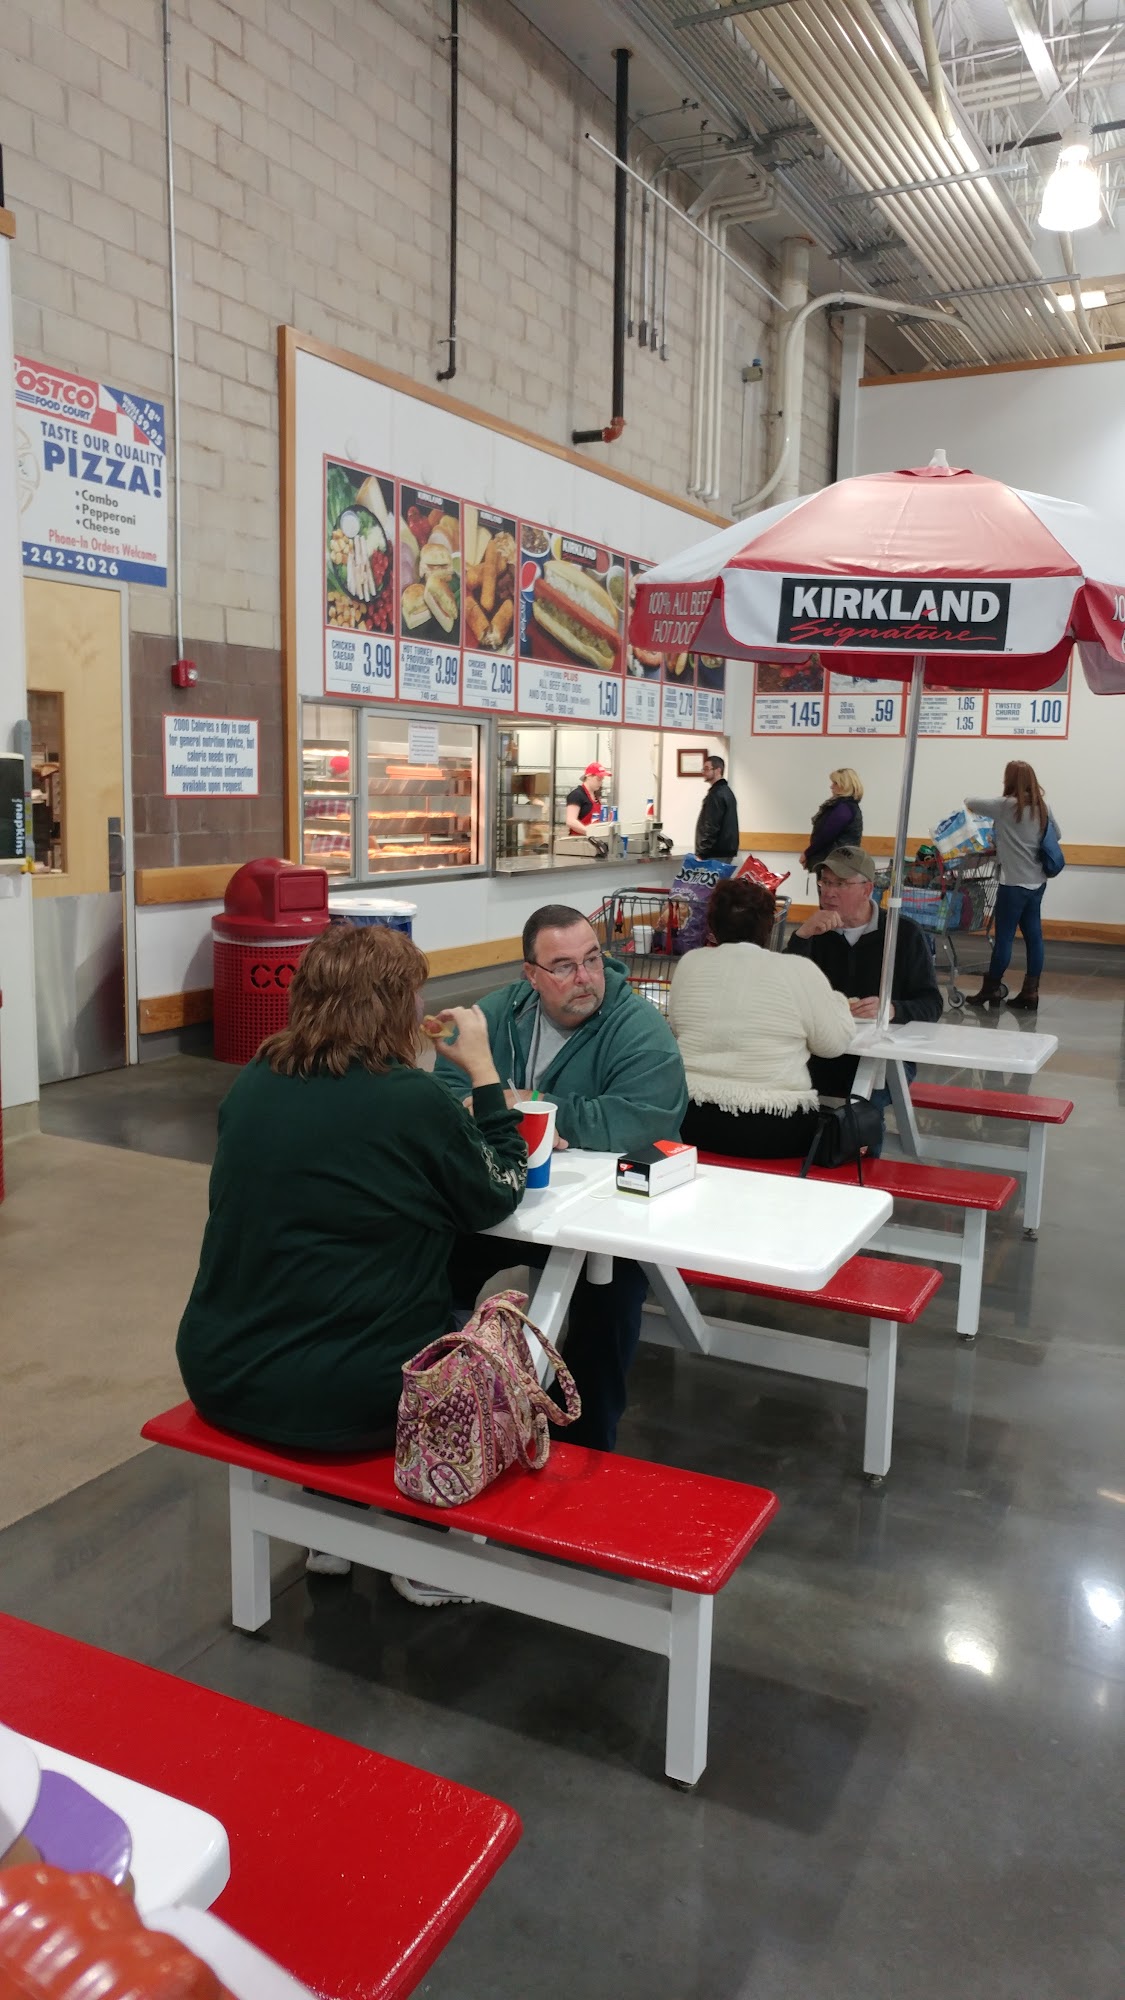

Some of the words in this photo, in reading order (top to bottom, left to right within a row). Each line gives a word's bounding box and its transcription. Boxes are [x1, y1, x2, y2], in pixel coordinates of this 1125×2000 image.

[15, 366, 95, 410] OSTCO
[35, 396, 61, 411] FOOD
[62, 405, 91, 421] COURT
[41, 421, 78, 445] TASTE
[84, 434, 110, 454] OUR
[115, 443, 163, 468] QUALITY
[44, 440, 162, 499] PIZZA!
[81, 489, 119, 508] Combo
[81, 503, 137, 526] Pepperoni
[82, 517, 120, 536] Cheese
[49, 529, 89, 549] Phone-In
[91, 537, 120, 555] Orders
[122, 543, 157, 562] Welcome
[563, 539, 597, 561] KIRKLAND
[672, 592, 688, 616] ALL
[792, 585, 1001, 623] KIRKLAND
[1112, 594, 1125, 623] 10
[651, 620, 673, 643] HOT
[790, 618, 997, 648] Signature
[332, 639, 356, 651] CHICKEN
[333, 650, 355, 662] CAESAR
[334, 661, 353, 672] SALAD
[363, 642, 392, 679] 3.99
[435, 655, 458, 685] 3.99
[491, 662, 512, 694] 2.99
[563, 671, 579, 682] PLUS
[598, 680, 618, 717] 1.50
[957, 696, 976, 711] 1.65
[995, 702, 1021, 710] TWISTED
[790, 701, 822, 728] 1.45
[870, 699, 894, 722] .59
[1029, 699, 1062, 724] 1.00
[174, 718, 189, 732] 2000
[191, 719, 214, 732] Calories
[221, 721, 230, 736] day
[238, 722, 251, 734] used
[956, 716, 974, 731] 1.35
[1013, 727, 1025, 735] 530
[169, 734, 178, 747] for
[179, 735, 201, 749] general
[203, 735, 225, 748] nutrition
[187, 750, 206, 762] calorie
[208, 751, 224, 763] needs
[171, 764, 198, 777] Additional
[200, 765, 223, 777] nutrition
[224, 766, 253, 778] information
[182, 780, 206, 792] available
[208, 781, 221, 794] upon
[15, 804, 25, 855] napkins
